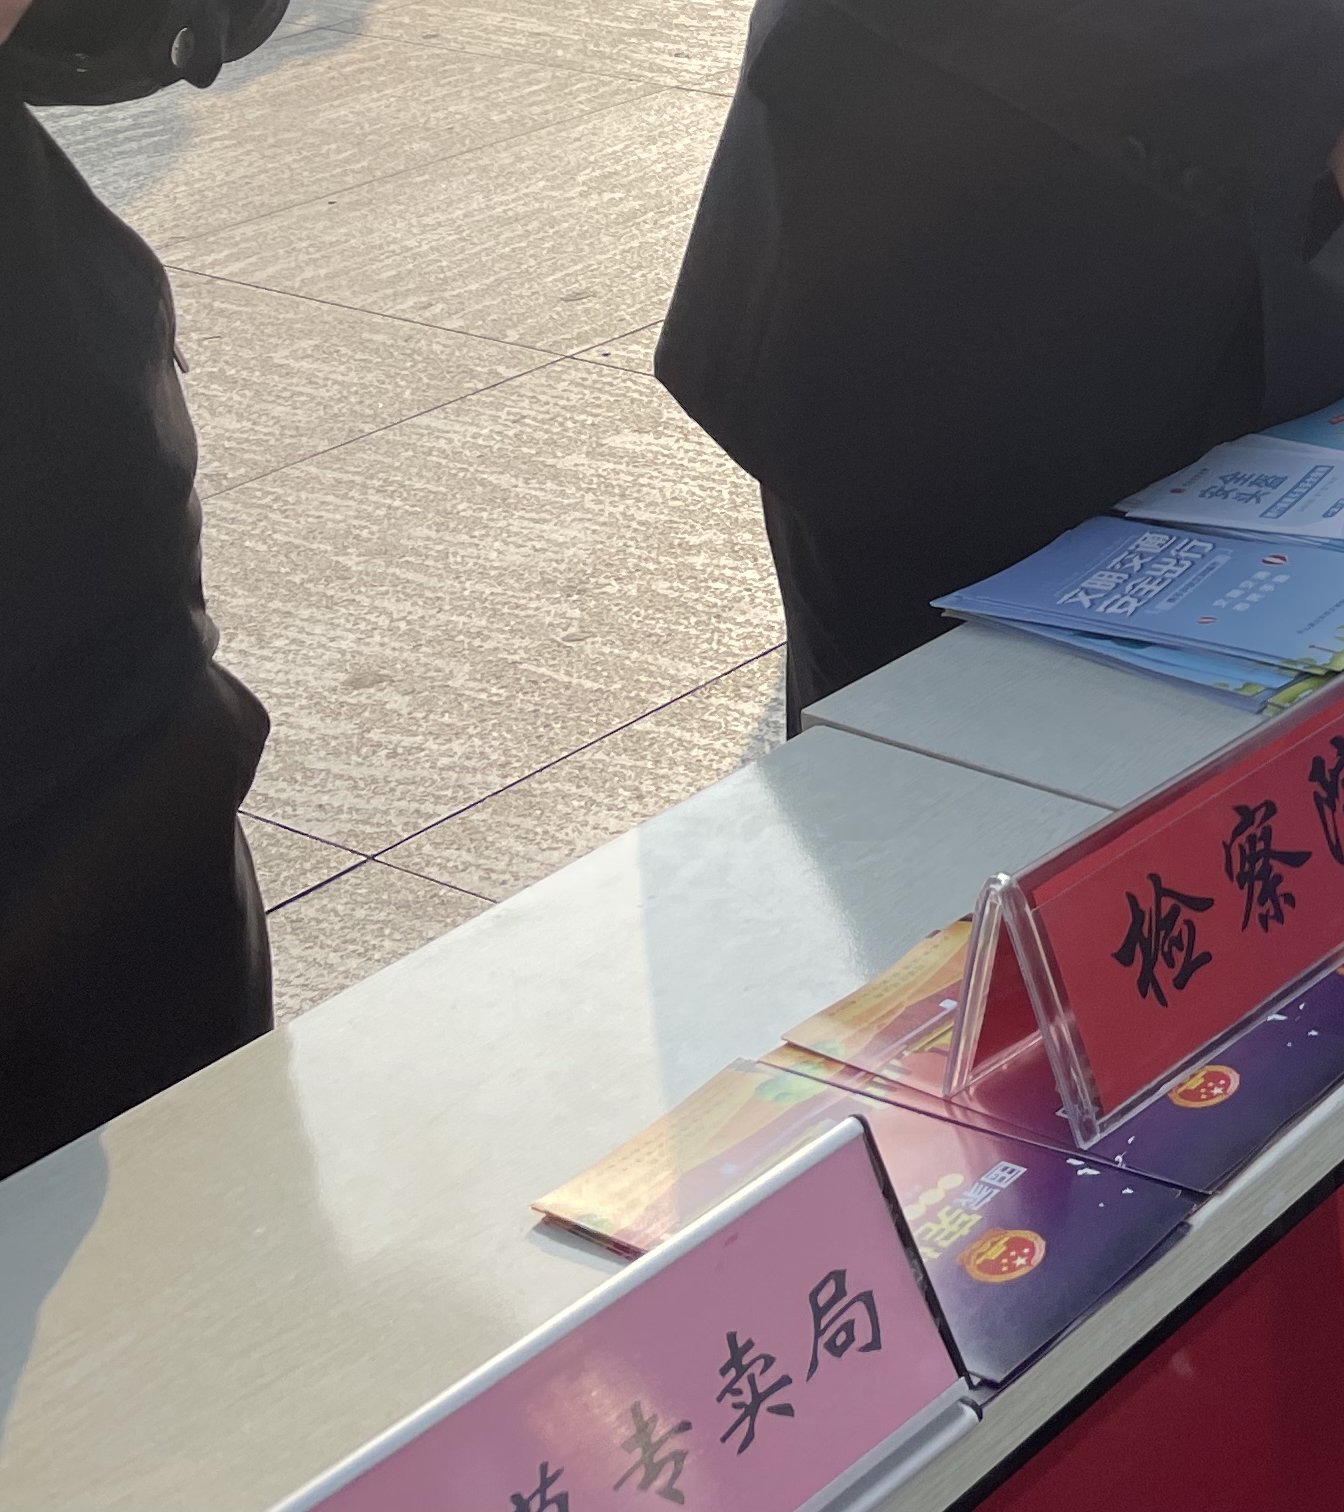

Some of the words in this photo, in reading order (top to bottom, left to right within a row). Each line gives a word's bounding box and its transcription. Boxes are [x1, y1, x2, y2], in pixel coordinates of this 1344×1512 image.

[1056, 531, 1178, 609] 文明交通
[1096, 536, 1215, 617] 安全出行
